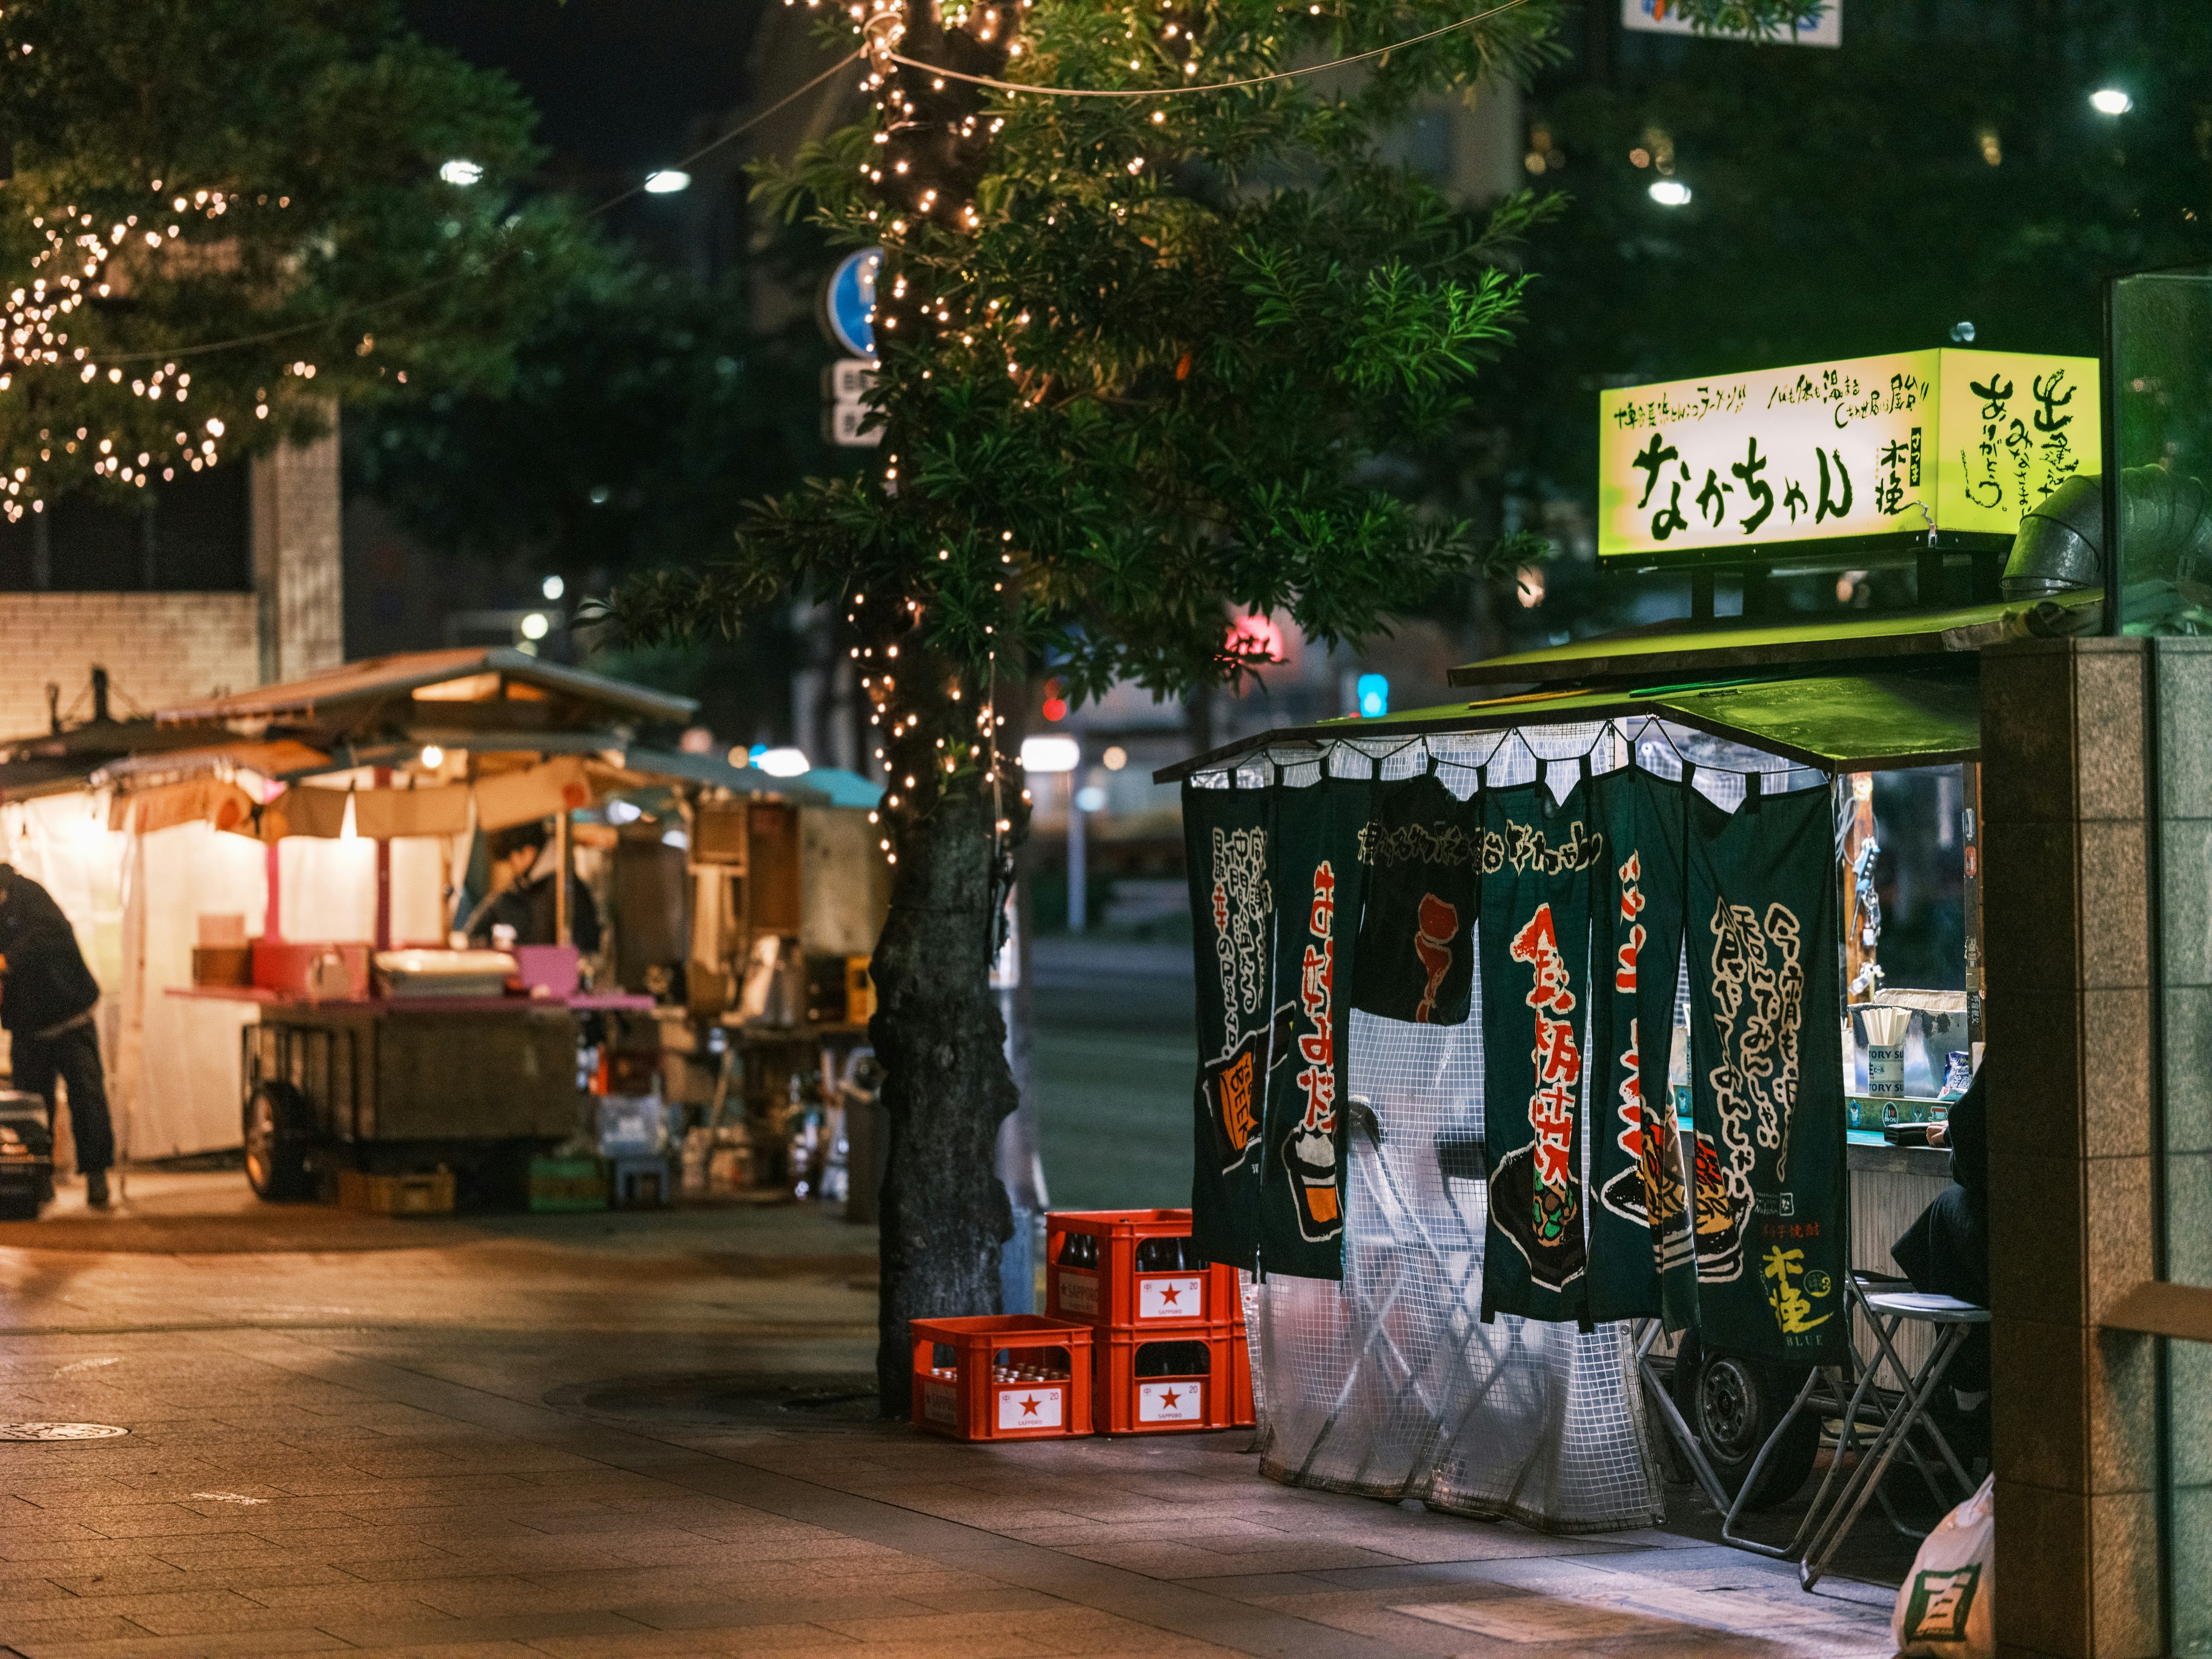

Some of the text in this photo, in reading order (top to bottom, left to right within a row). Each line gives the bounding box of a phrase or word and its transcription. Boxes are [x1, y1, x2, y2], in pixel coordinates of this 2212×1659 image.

[1911, 432, 1921, 483] さつま
[1632, 433, 1853, 540] なかちゃん
[1875, 439, 1916, 516] 木挽
[1189, 1282, 1198, 1290] 20
[1762, 1245, 1834, 1334] 木挽
[1787, 1335, 1822, 1347] BLUE
[1049, 1392, 1059, 1400] 20
[1189, 1385, 1198, 1394] 20
